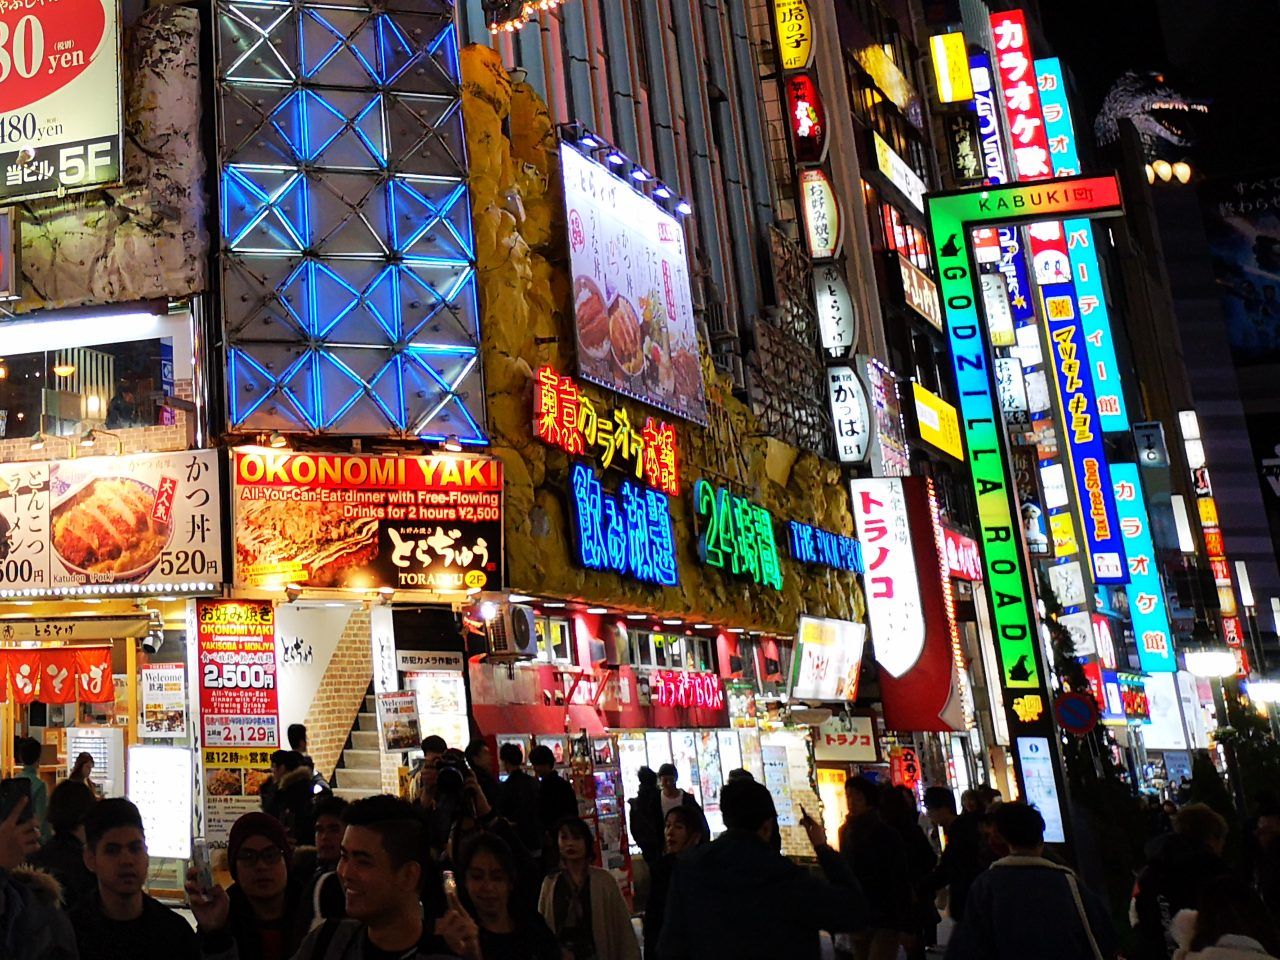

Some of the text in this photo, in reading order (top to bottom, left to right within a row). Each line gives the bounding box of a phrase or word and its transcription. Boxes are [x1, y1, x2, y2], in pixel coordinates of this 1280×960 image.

[780, 6, 809, 49] 虎の子
[47, 48, 85, 75] yen
[36, 121, 64, 142] yen
[5, 141, 112, 187] 当ビル 5F
[1067, 228, 1120, 416] パーティー館
[1052, 327, 1093, 444] マツモトキヨシ
[942, 264, 1004, 497] GODZILLA
[983, 524, 1027, 641] ROAD
[239, 453, 500, 488] OKONOMI YAKI
[7, 473, 23, 557] ラーメン
[26, 469, 45, 555] とんこつ
[153, 478, 174, 521] 大人気
[184, 455, 211, 544] かつ丼
[241, 488, 500, 507] All-You-Can-Eat dinner with Free-Flowing
[343, 505, 500, 522] Drinks for hours ¥2,500
[1084, 457, 1111, 541] Tax Free Shop
[160, 549, 218, 576] 520円
[387, 526, 490, 568] とらぢゅう
[858, 491, 894, 599] トラノコ
[1114, 481, 1168, 654] カラオケ館
[34, 623, 75, 636] とらそば
[200, 605, 272, 622] お好み焼き
[200, 624, 248, 635] OKONOMI
[145, 672, 182, 683] Welcome
[204, 664, 274, 689] 2,500円
[401, 655, 461, 666] 防犯カメラ作動中
[223, 726, 275, 742] 2,129円
[825, 734, 871, 747] トラノコ
